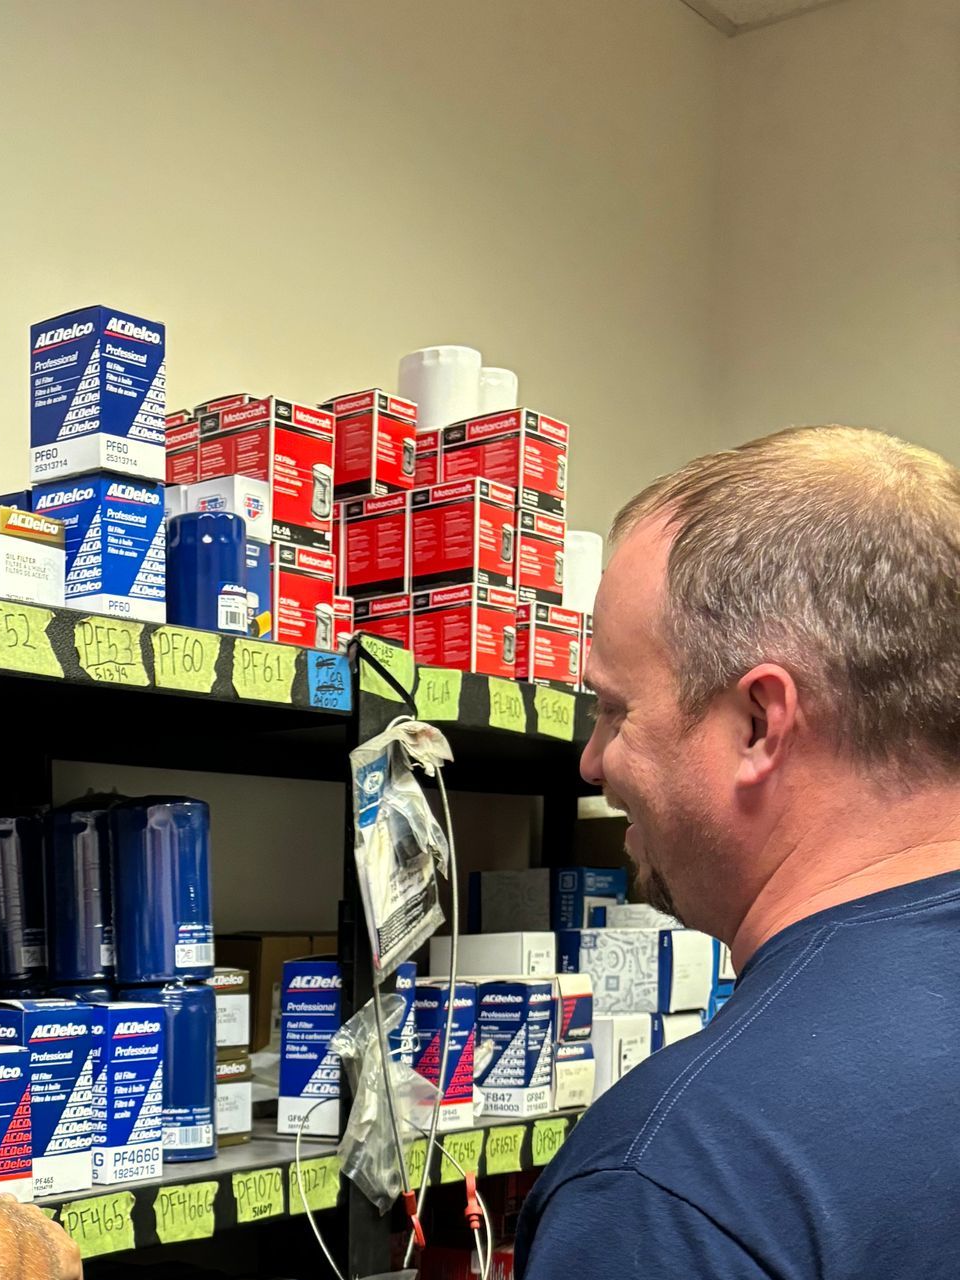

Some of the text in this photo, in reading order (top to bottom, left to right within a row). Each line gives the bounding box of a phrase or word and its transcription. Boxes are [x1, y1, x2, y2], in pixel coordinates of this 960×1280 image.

[35, 323, 93, 349] ACDelco
[106, 318, 160, 344] ACDelco
[34, 351, 78, 371] Professional
[106, 344, 146, 363] Professional
[337, 397, 371, 412] Motorcraft
[224, 405, 266, 423] Motorcraft
[296, 410, 331, 429] Motorcraft
[470, 418, 516, 435] Motorcraft
[106, 440, 128, 454] PF60
[35, 448, 58, 462] PF60
[35, 460, 67, 473] 25313714
[107, 484, 159, 504] ACDelco
[434, 484, 472, 498] Motorcraft
[37, 488, 94, 510] ACDelco
[367, 497, 403, 512] Motorcraft
[8, 513, 58, 534] ACDelco
[107, 509, 147, 524] Professional
[298, 553, 333, 570] Motorcraft
[433, 589, 469, 603] Motorcraft
[109, 600, 130, 612] PF60
[373, 599, 408, 613] Motorcraft
[82, 621, 133, 666] PF53
[159, 634, 205, 677] PF60
[242, 648, 284, 686] PF61
[482, 994, 523, 1004] ACDelco
[529, 993, 551, 1002] ACDelco
[287, 1002, 336, 1011] Professional
[480, 1010, 520, 1020] Professional
[31, 1025, 87, 1038] ACDelco
[114, 1022, 161, 1034] ACDelco
[31, 1050, 73, 1062] Professional
[115, 1045, 158, 1056] Professional
[557, 1046, 584, 1057] ACDelco
[114, 1147, 159, 1167] PF466G
[114, 1166, 155, 1179] 19254715
[237, 1172, 282, 1213] PF1070
[160, 1190, 214, 1232] PF466G
[66, 1200, 124, 1239] PF465
